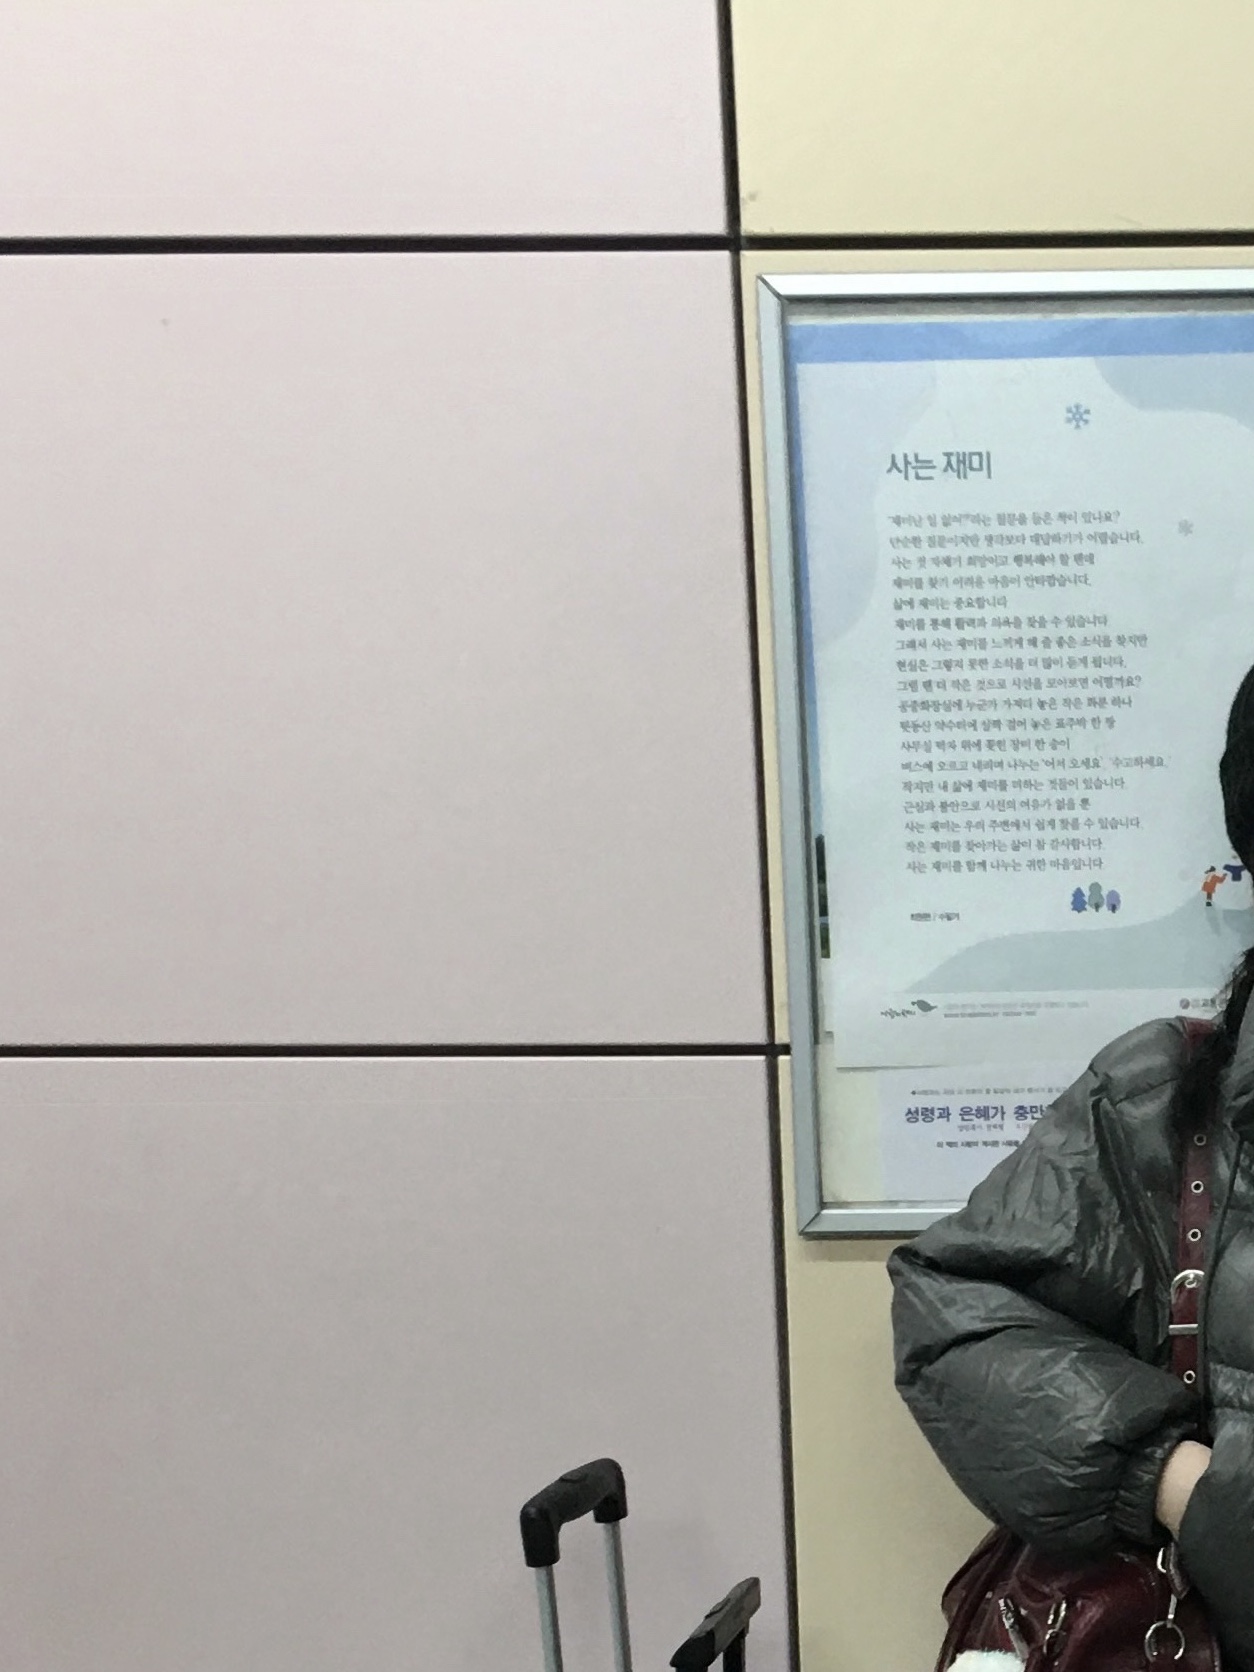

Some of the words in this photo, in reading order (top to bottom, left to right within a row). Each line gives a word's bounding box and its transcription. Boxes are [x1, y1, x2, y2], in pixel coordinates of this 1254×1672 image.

[886, 452, 937, 481] 사는
[942, 450, 992, 480] 재미
[1050, 615, 1061, 628] 수
[932, 638, 952, 651] 사는
[1035, 737, 1046, 751] 한
[937, 760, 968, 772] 오르고
[905, 820, 925, 834] 사는
[1084, 817, 1095, 831] 수
[907, 861, 927, 874] 사는
[905, 1105, 952, 1124] 성령과
[959, 1104, 1006, 1122] 은혜가
